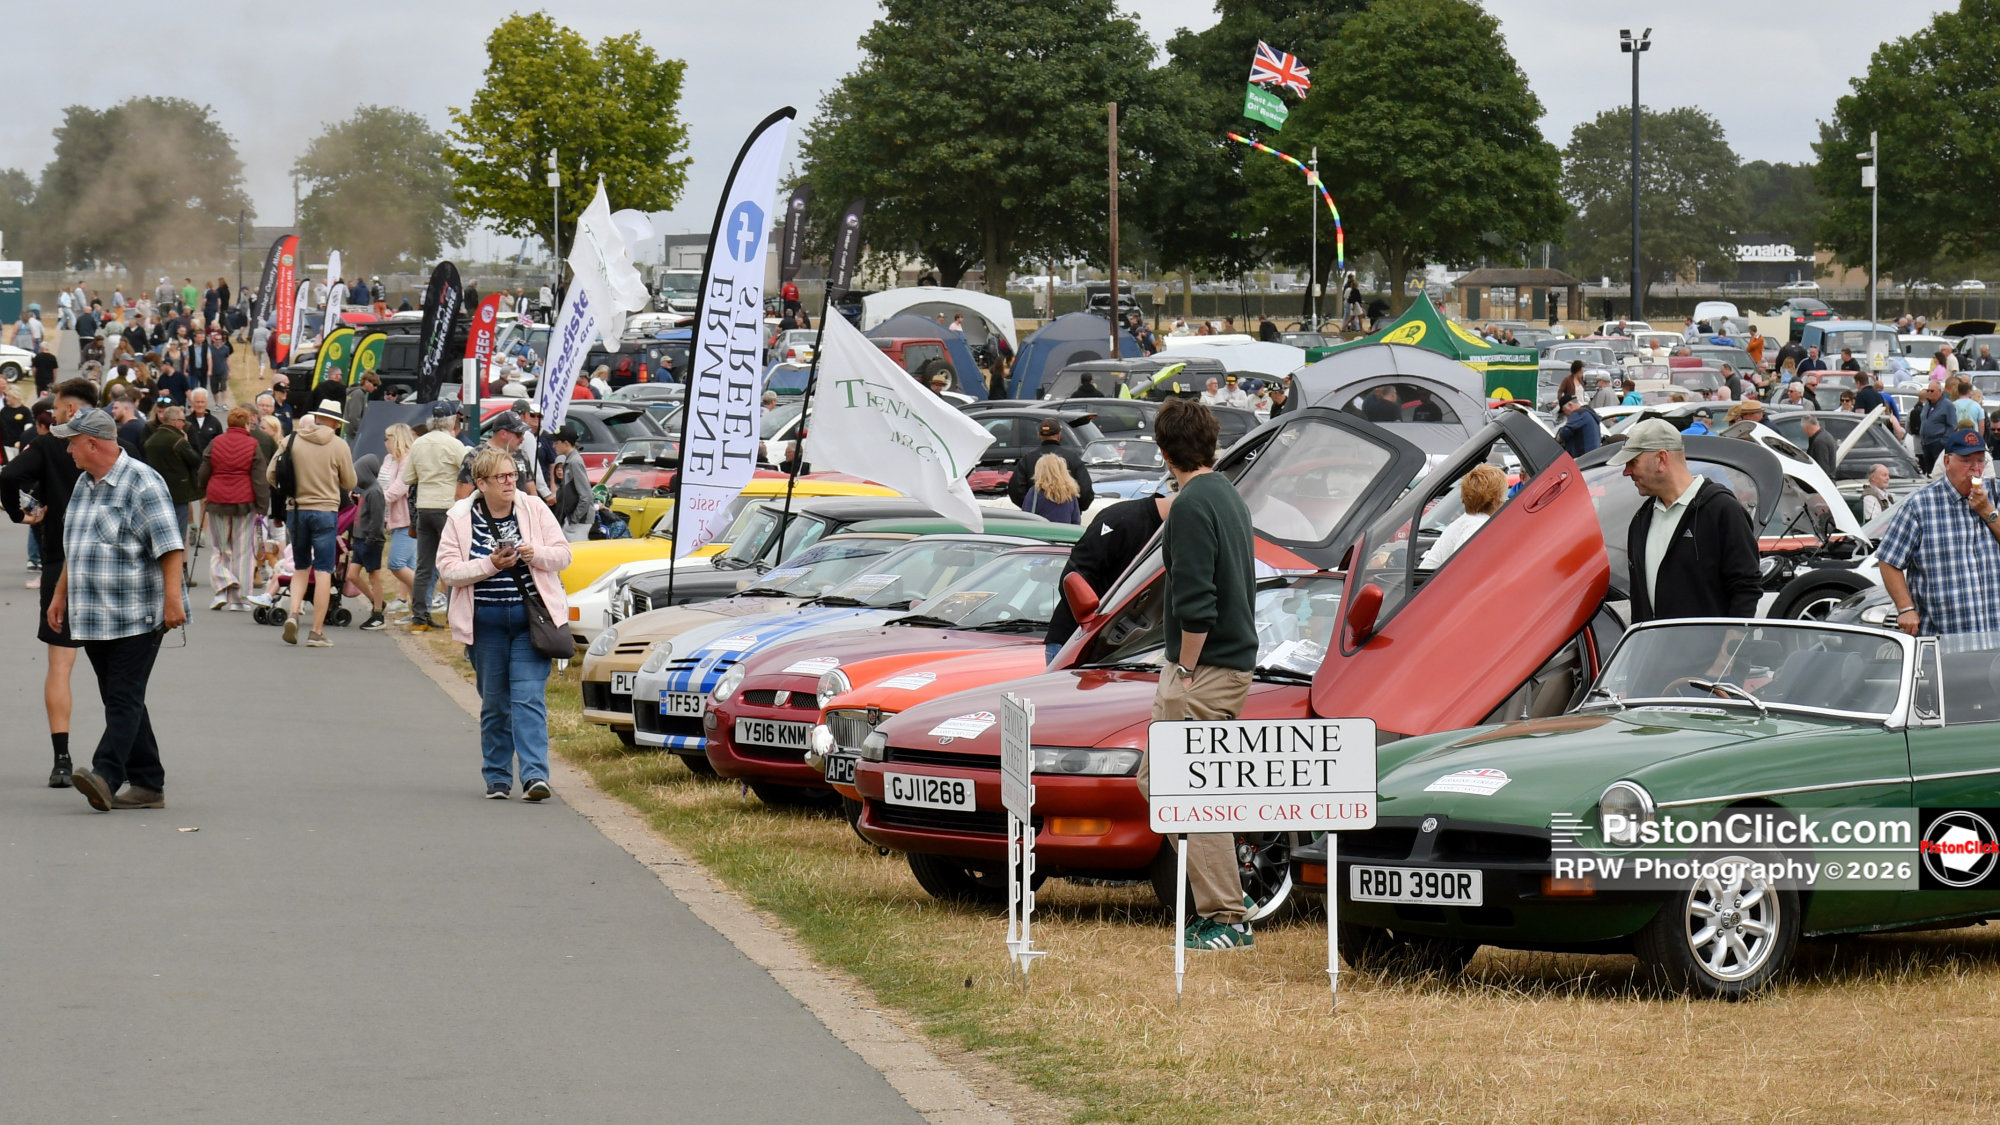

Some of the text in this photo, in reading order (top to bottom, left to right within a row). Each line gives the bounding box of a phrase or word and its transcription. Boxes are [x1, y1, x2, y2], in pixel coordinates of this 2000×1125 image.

[1735, 243, 1795, 257] Donald's
[549, 288, 589, 394] Registe
[547, 316, 595, 431] incolnshire Gro
[668, 694, 700, 713] TF53
[744, 722, 807, 745] Y516 KNM
[1183, 724, 1342, 754] ERMINE
[1188, 759, 1337, 789] STREET
[1158, 803, 1368, 822] CLASSIC CAR CLUB
[1360, 869, 1472, 900] RBD 390R
